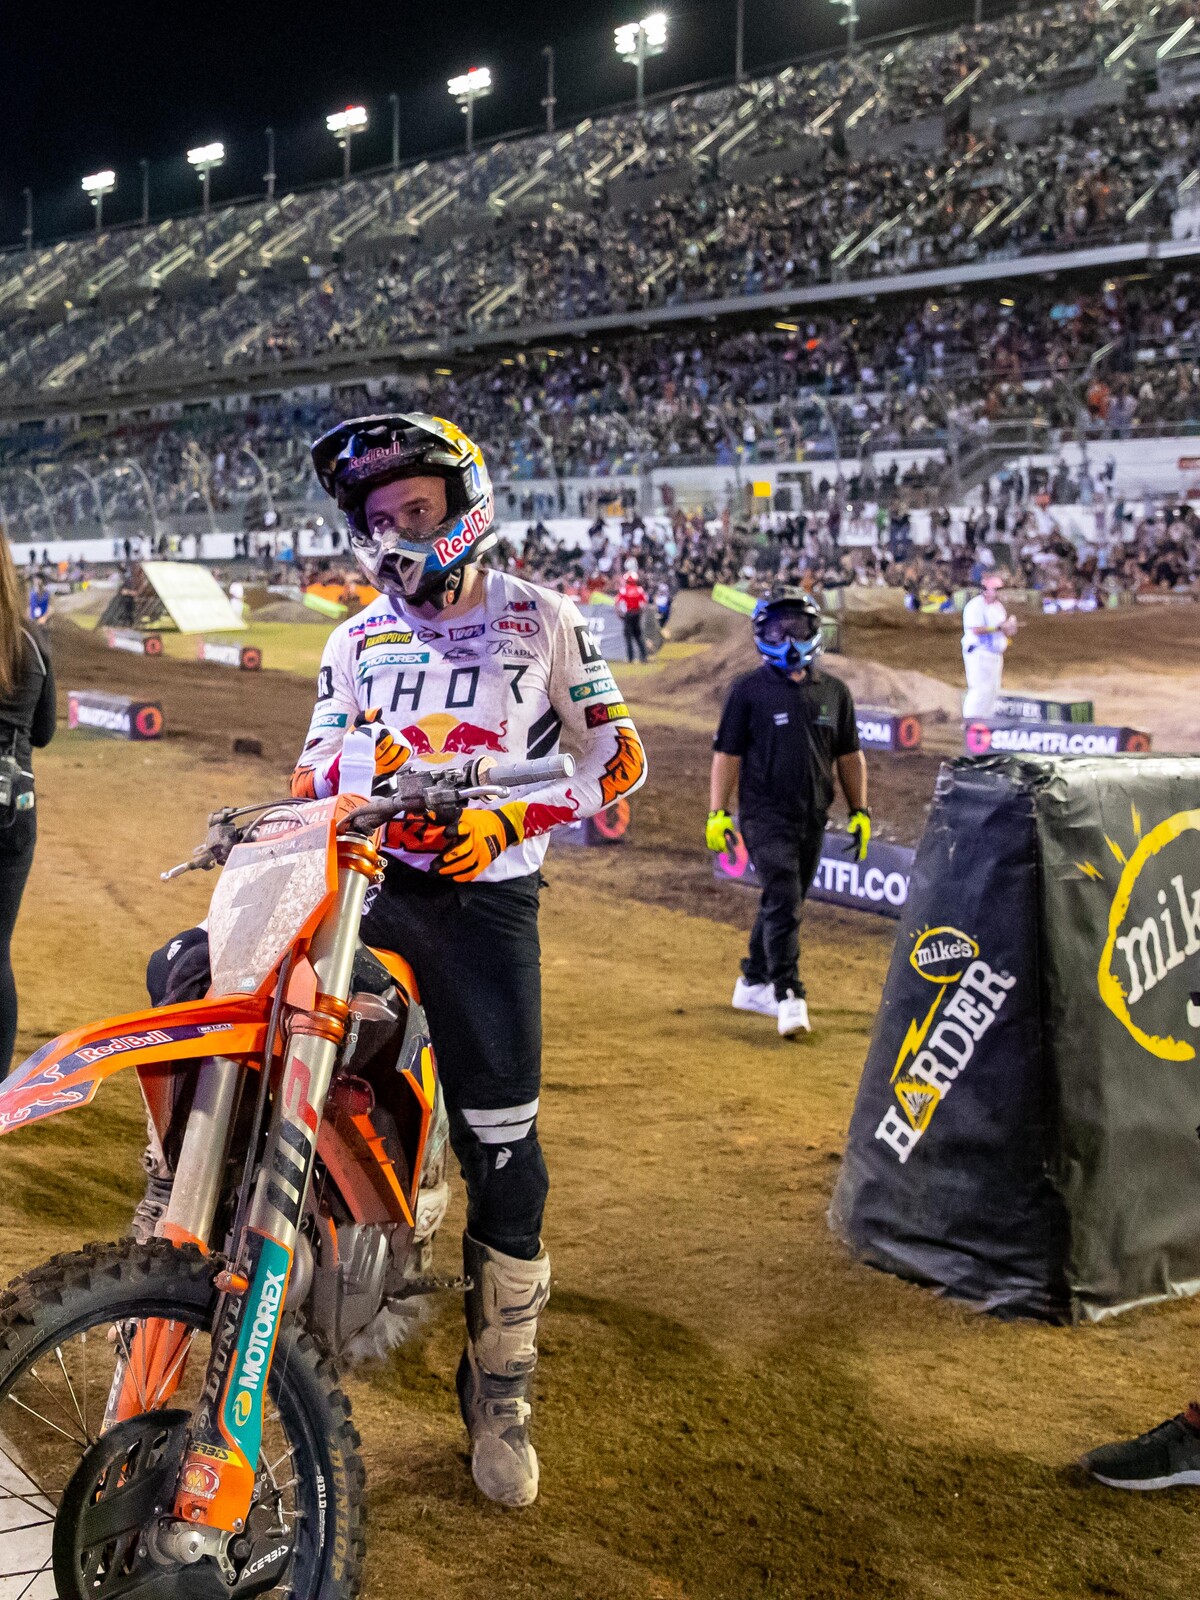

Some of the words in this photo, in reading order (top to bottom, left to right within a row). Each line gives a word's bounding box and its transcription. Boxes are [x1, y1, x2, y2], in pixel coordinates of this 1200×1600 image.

[433, 514, 476, 566] Red
[498, 621, 533, 632] BELL
[365, 654, 423, 667] MOTOREX
[812, 857, 910, 906] TFI.CO
[916, 939, 973, 967] mike's
[75, 1038, 124, 1063] Red
[123, 1030, 174, 1049] Bull
[238, 1269, 286, 1390] MOTOREX
[241, 1545, 289, 1581] ACERBIS
